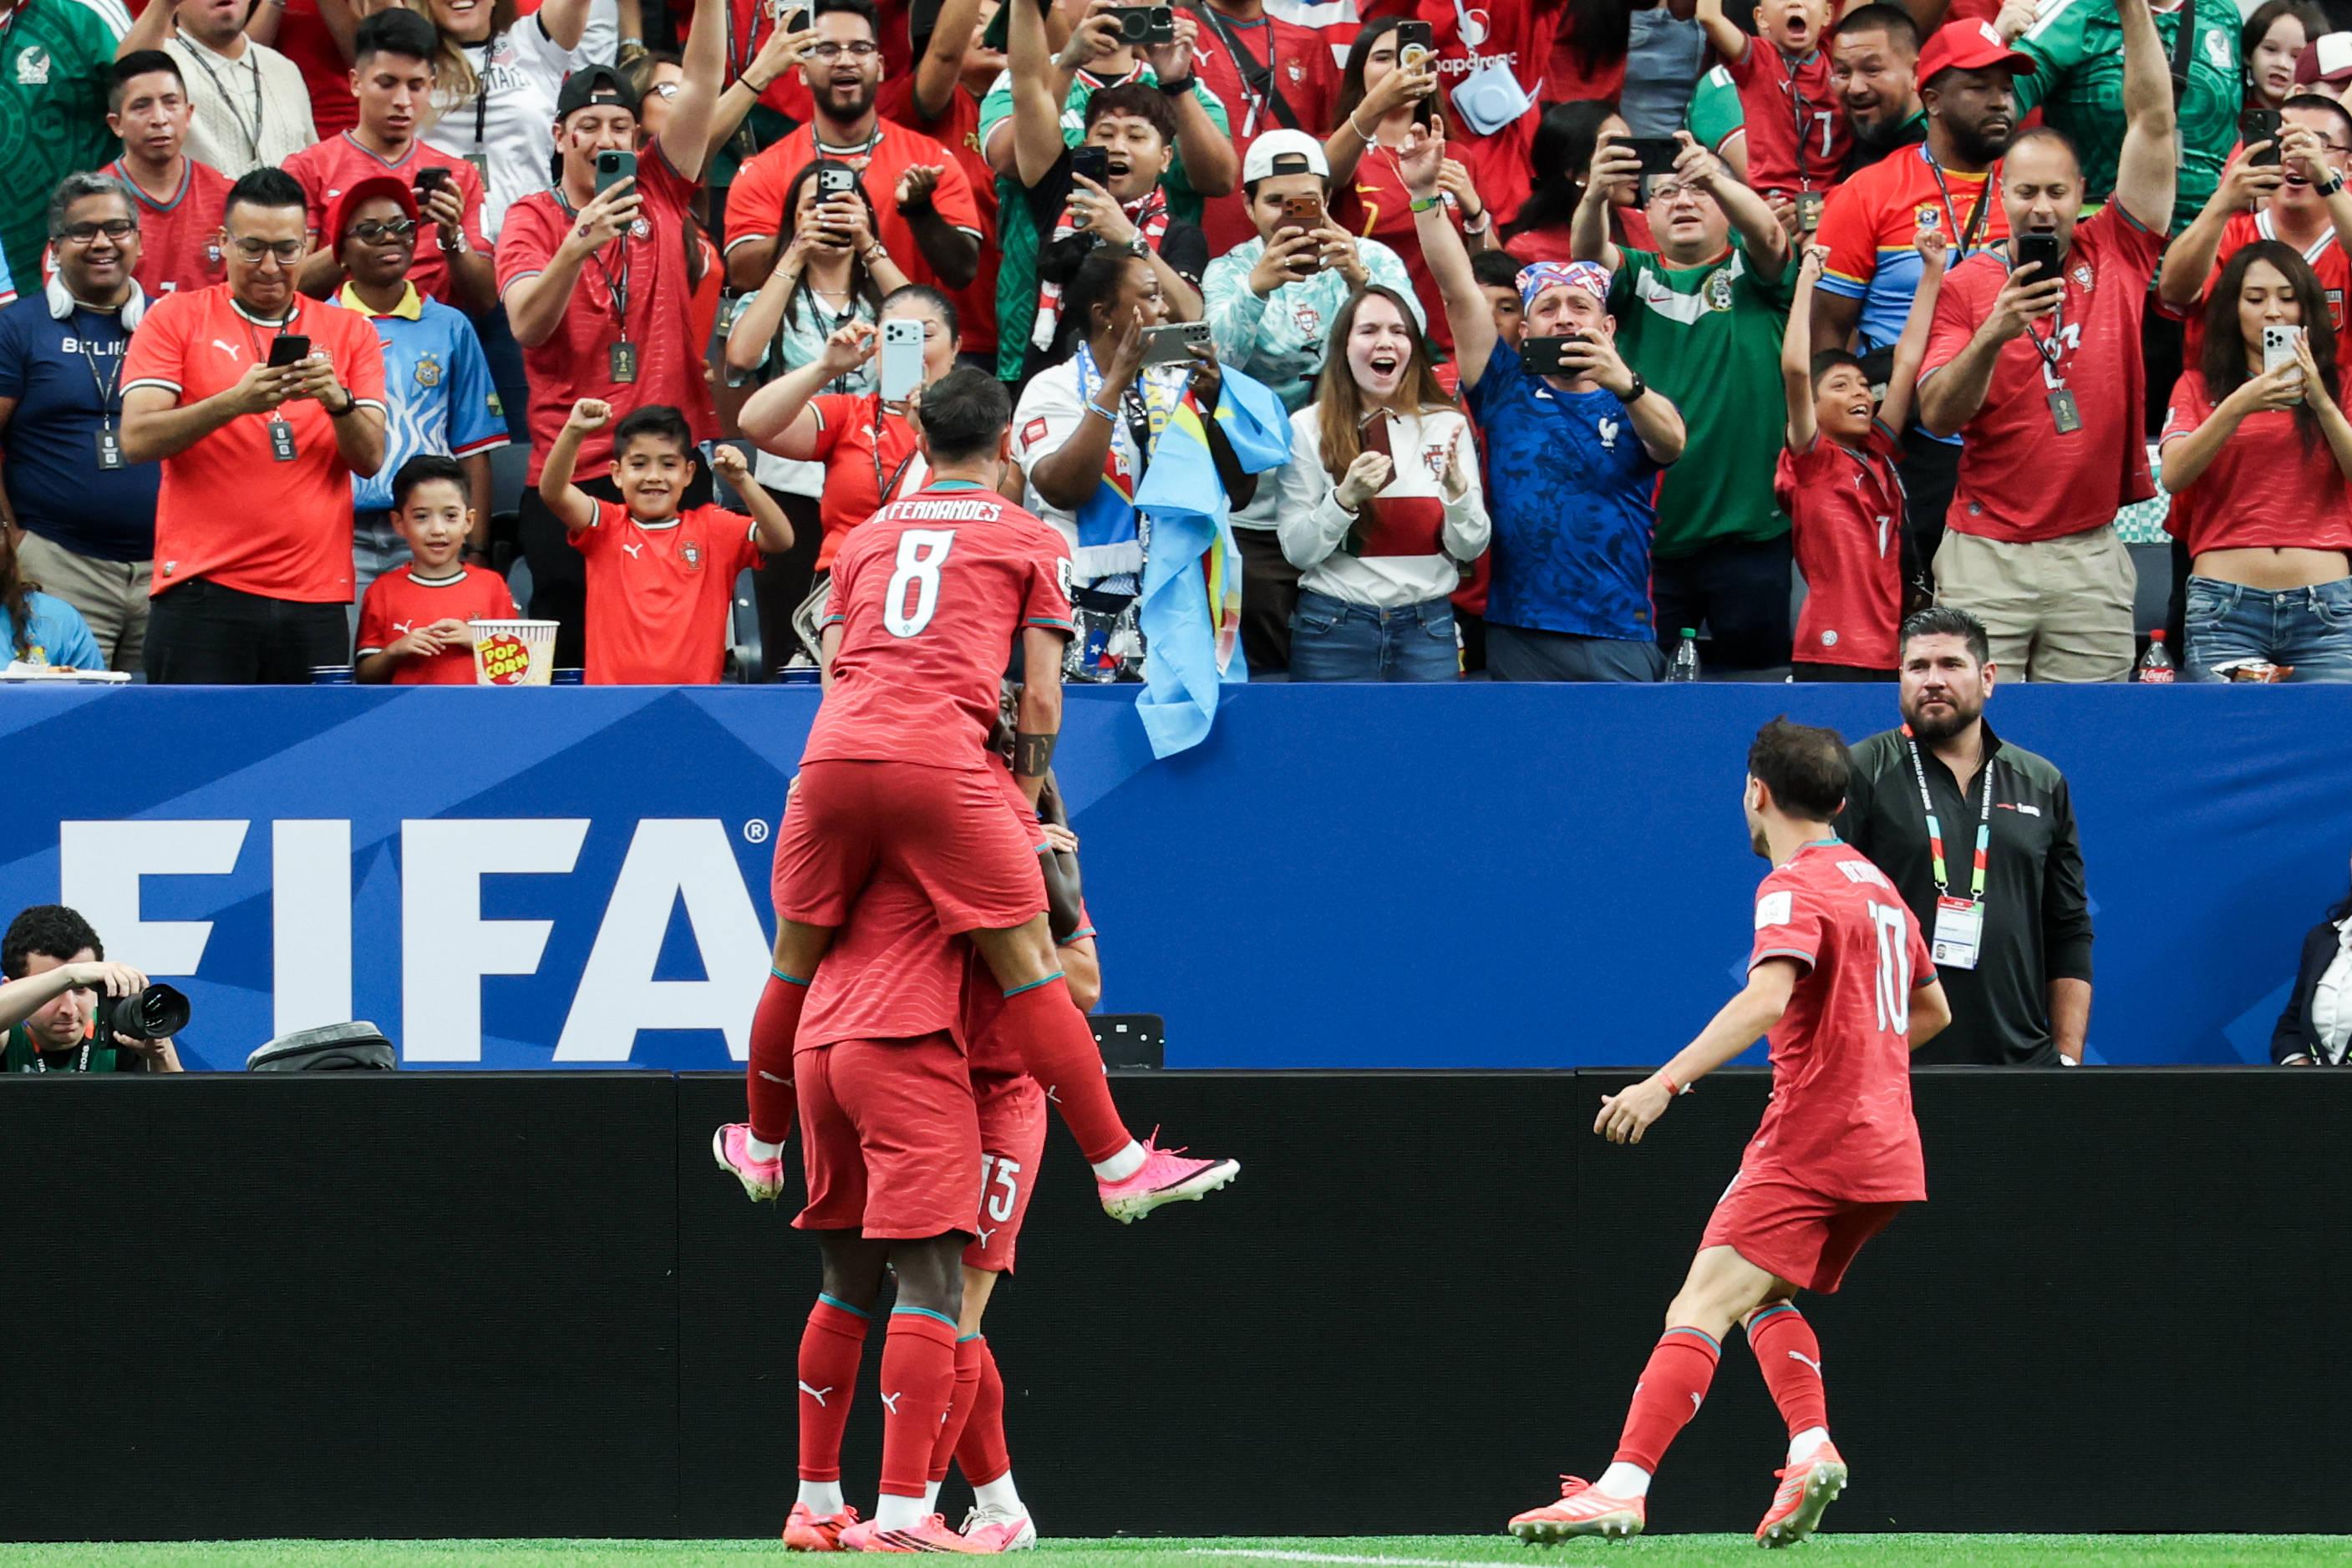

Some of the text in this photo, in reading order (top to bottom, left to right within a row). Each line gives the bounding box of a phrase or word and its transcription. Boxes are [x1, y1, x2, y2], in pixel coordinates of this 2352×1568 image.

[1241, 92, 1262, 138] 7
[1813, 110, 1832, 158] 7
[888, 500, 1003, 523] FERNANDES
[883, 528, 957, 638] 8
[485, 643, 518, 664] POP
[485, 652, 528, 679] CORN
[60, 817, 774, 1063] FIFA
[1867, 898, 1909, 1035] 10
